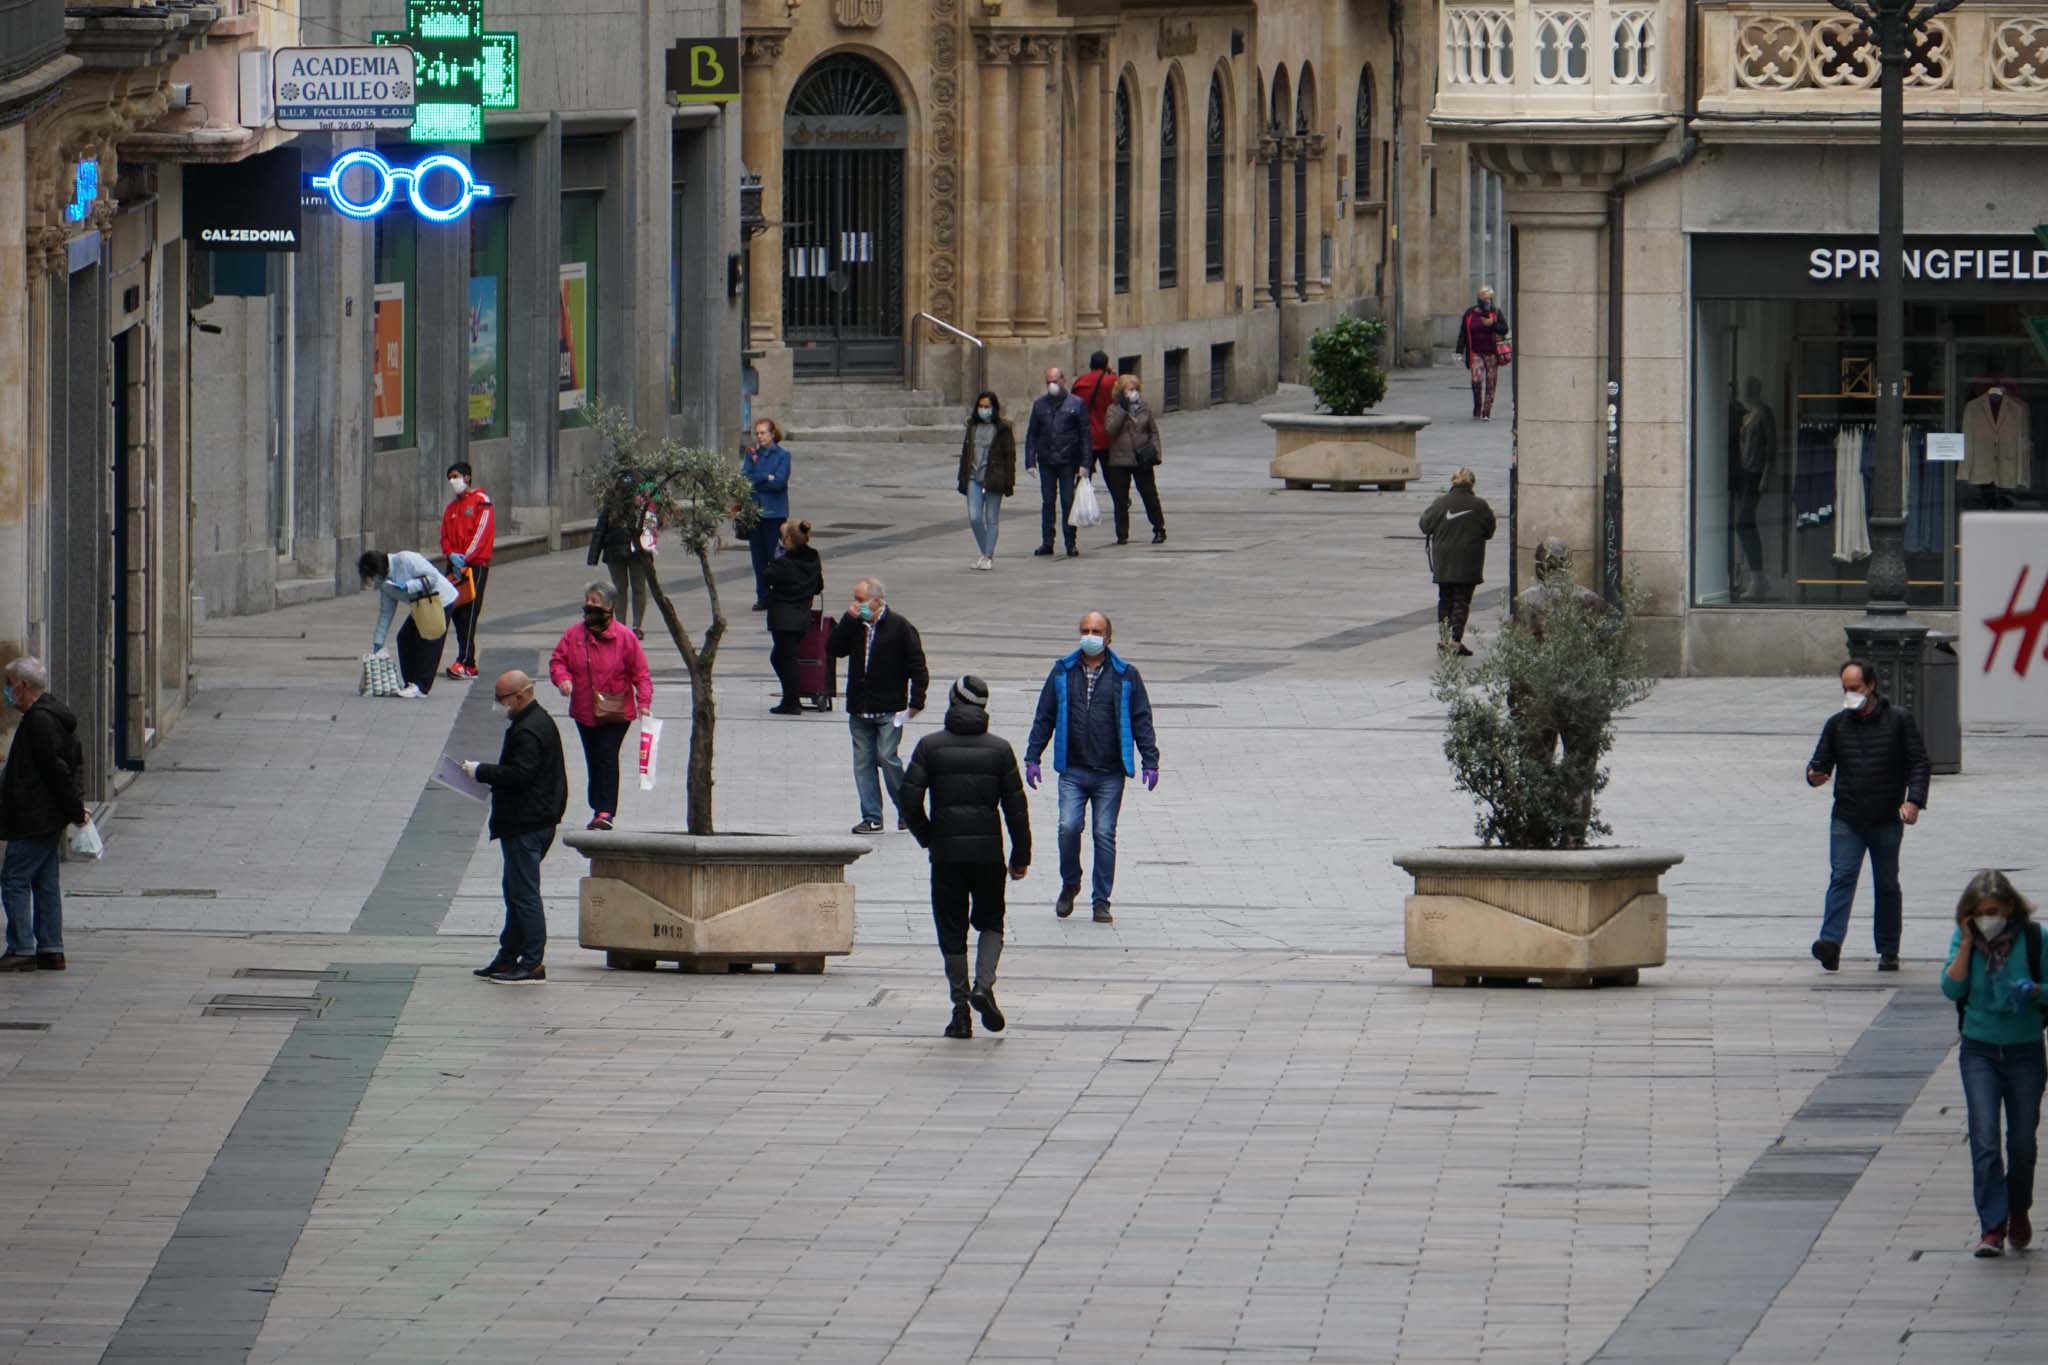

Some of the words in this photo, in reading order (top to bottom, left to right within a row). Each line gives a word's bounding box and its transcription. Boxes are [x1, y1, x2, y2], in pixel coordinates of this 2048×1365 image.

[292, 56, 400, 77] ACADEMIA
[690, 45, 725, 87] B
[302, 81, 389, 101] GALILEO
[279, 109, 308, 118] B.U.P.
[313, 108, 377, 117] FACULTADES
[381, 108, 413, 117] C.O.U.
[201, 229, 296, 242] CALZEDONIA
[1808, 248, 2048, 279] SPRNGFIELD
